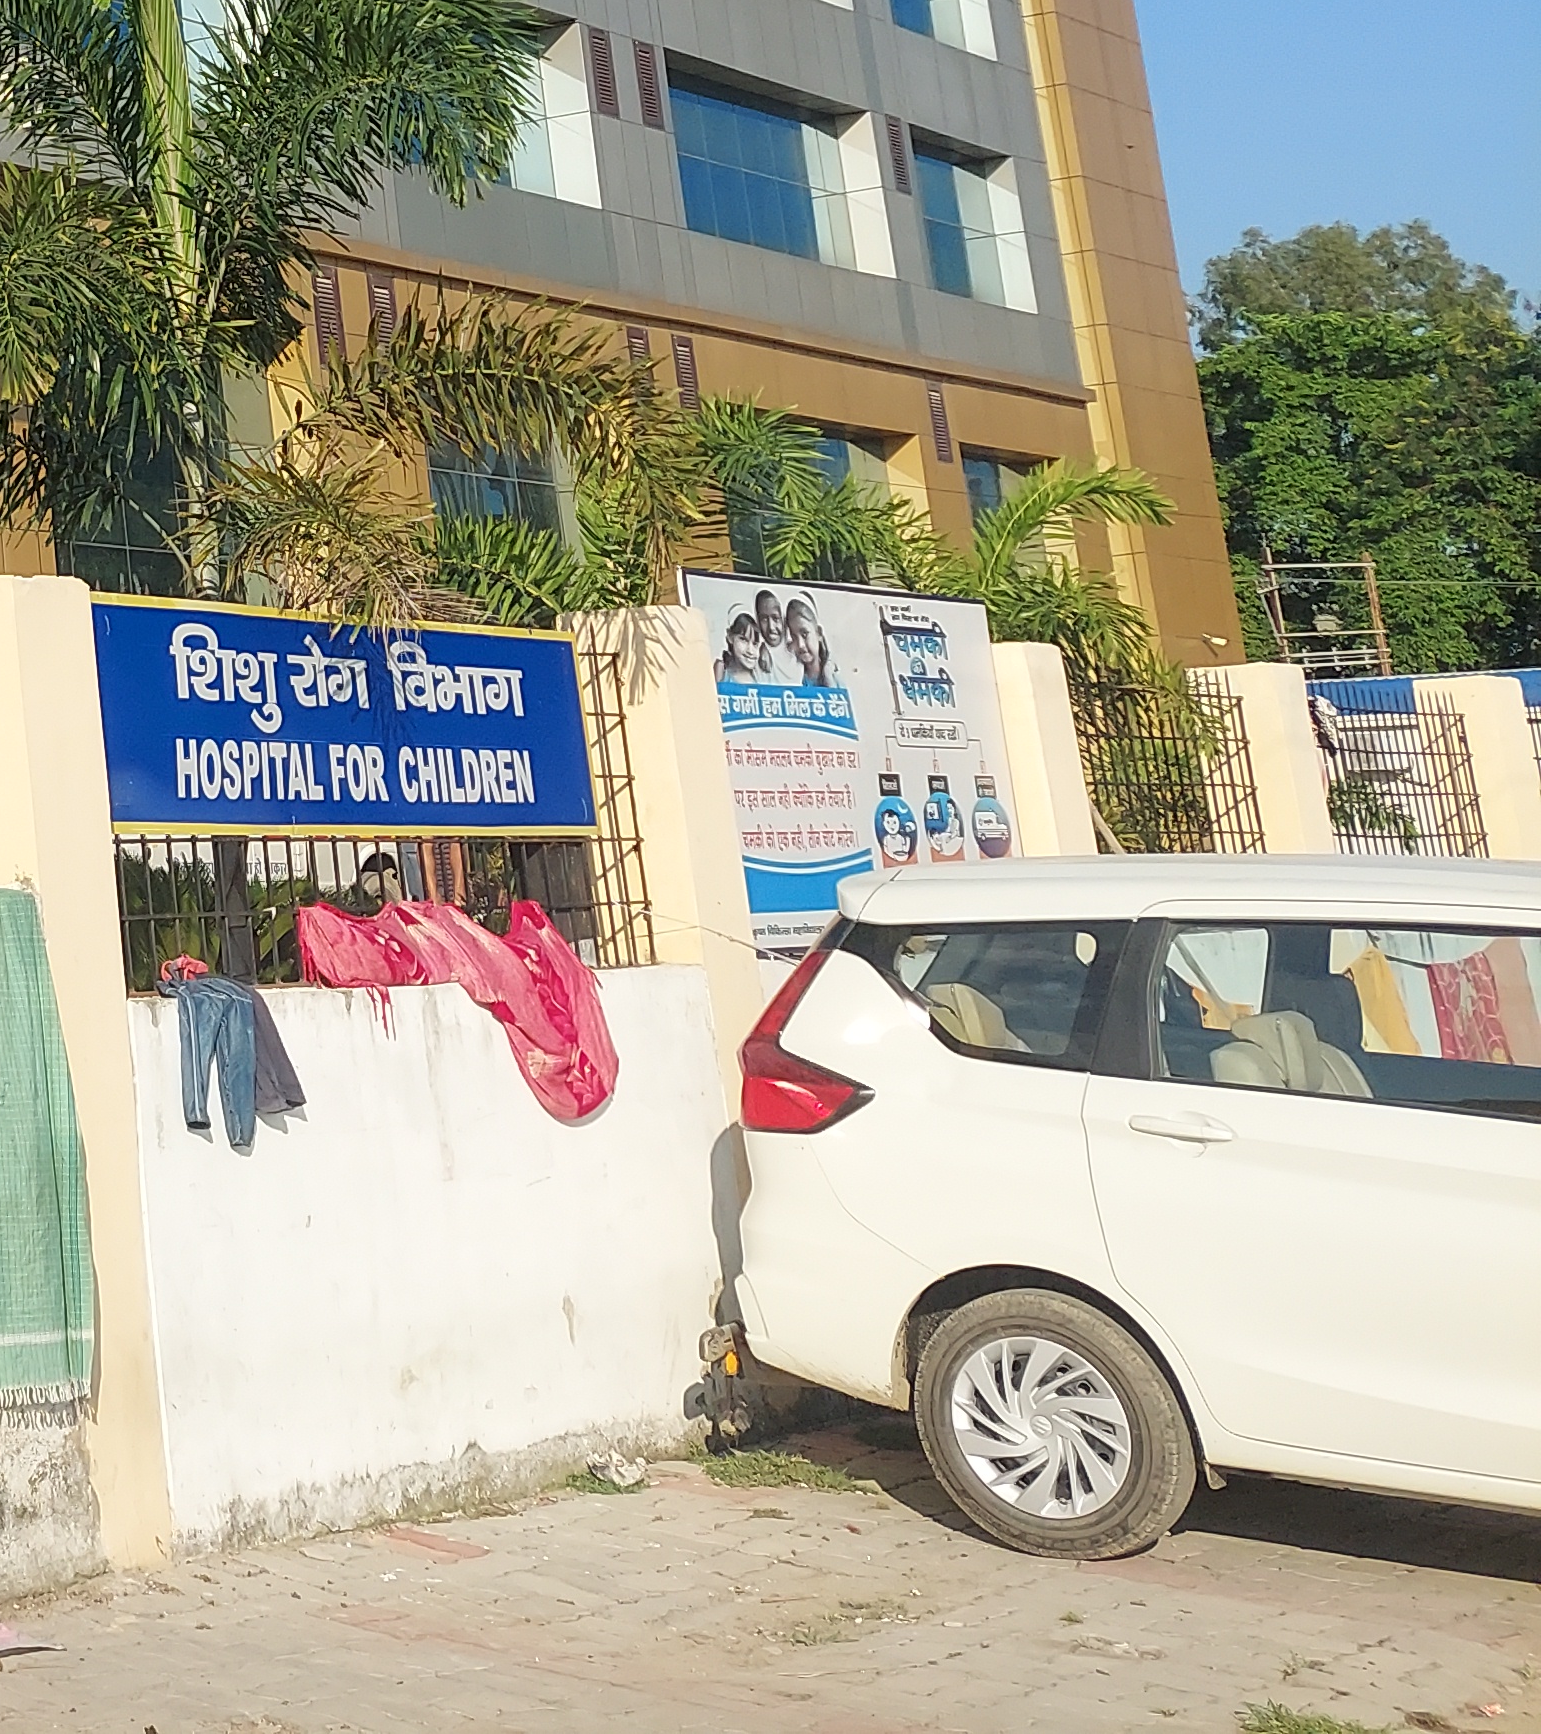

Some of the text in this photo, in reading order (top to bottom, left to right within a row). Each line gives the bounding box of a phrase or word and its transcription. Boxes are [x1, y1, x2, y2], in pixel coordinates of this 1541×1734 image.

[891, 619, 949, 661] चमकी
[169, 622, 525, 734] शिशु रोग विभाग
[898, 667, 956, 709] धमकी
[718, 694, 731, 715] स
[732, 688, 760, 716] गर्मी
[761, 696, 783, 718] हम
[784, 690, 811, 718] मिल
[810, 693, 827, 718] के
[176, 737, 536, 805] HOSPITAL FOR CHILDREN
[733, 789, 746, 808] पर
[745, 789, 759, 813] इस
[759, 790, 777, 808] साल
